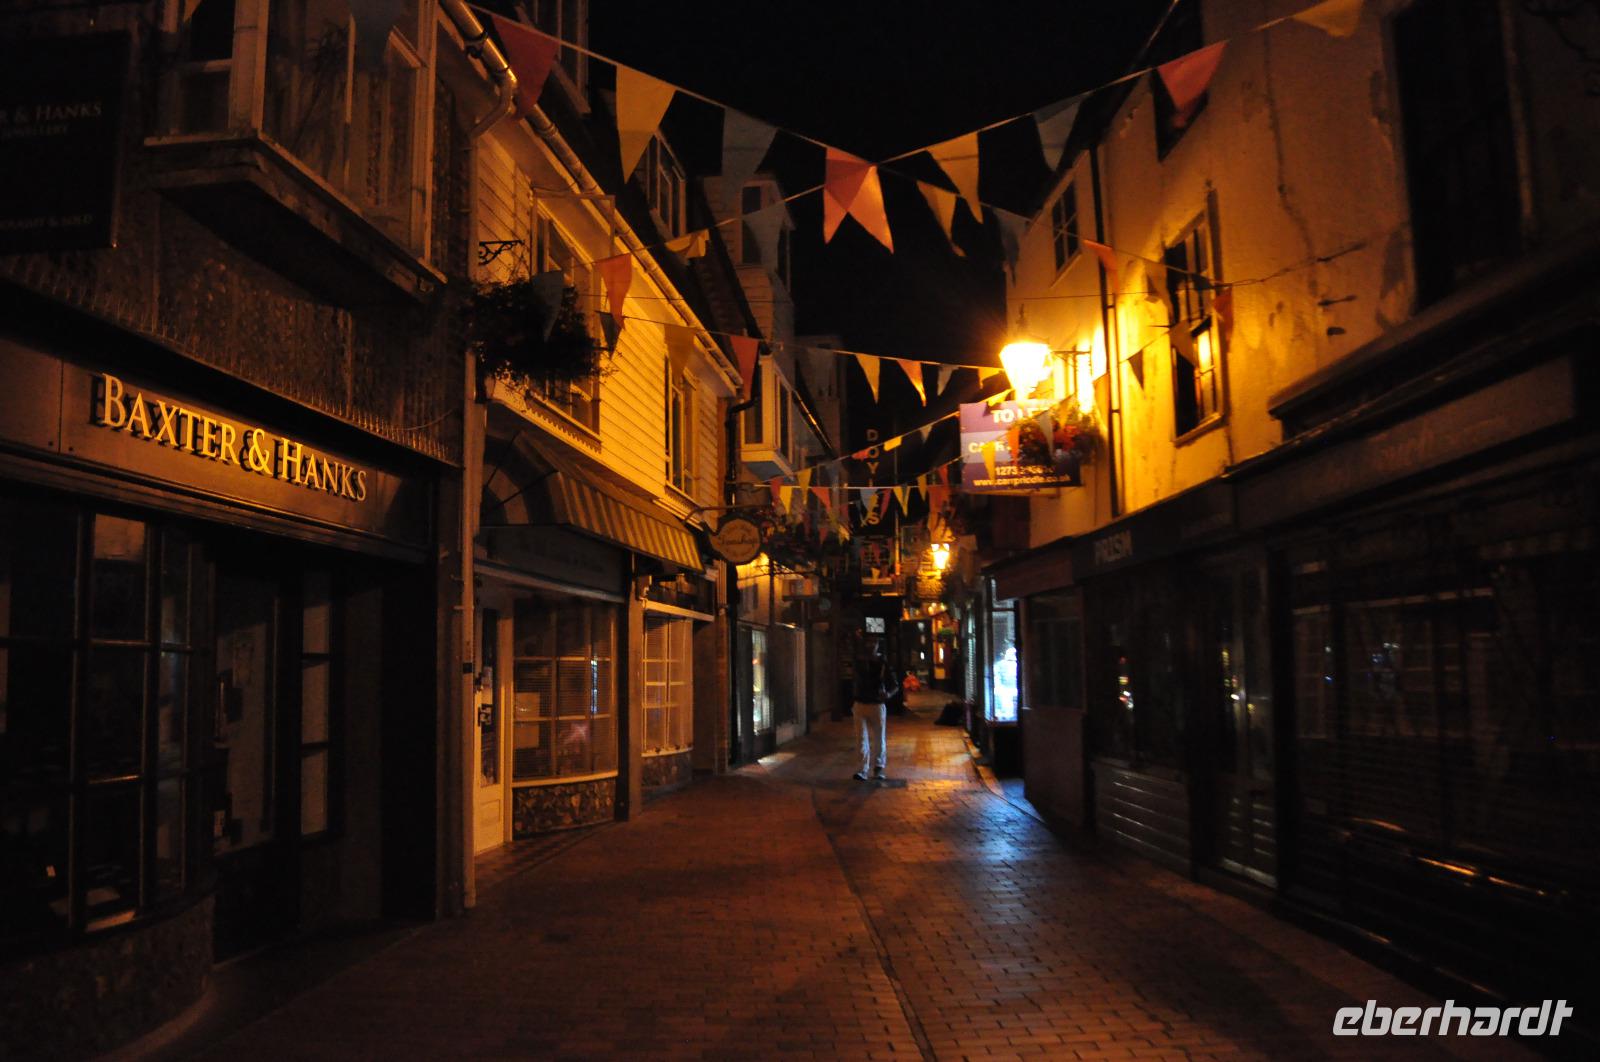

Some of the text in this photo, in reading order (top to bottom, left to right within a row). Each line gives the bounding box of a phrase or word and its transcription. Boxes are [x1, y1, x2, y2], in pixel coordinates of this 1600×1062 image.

[36, 102, 102, 121] HANKS
[102, 373, 367, 501] BAXTER & HANKS
[992, 409, 1014, 423] TO
[866, 428, 881, 525] DOYLS
